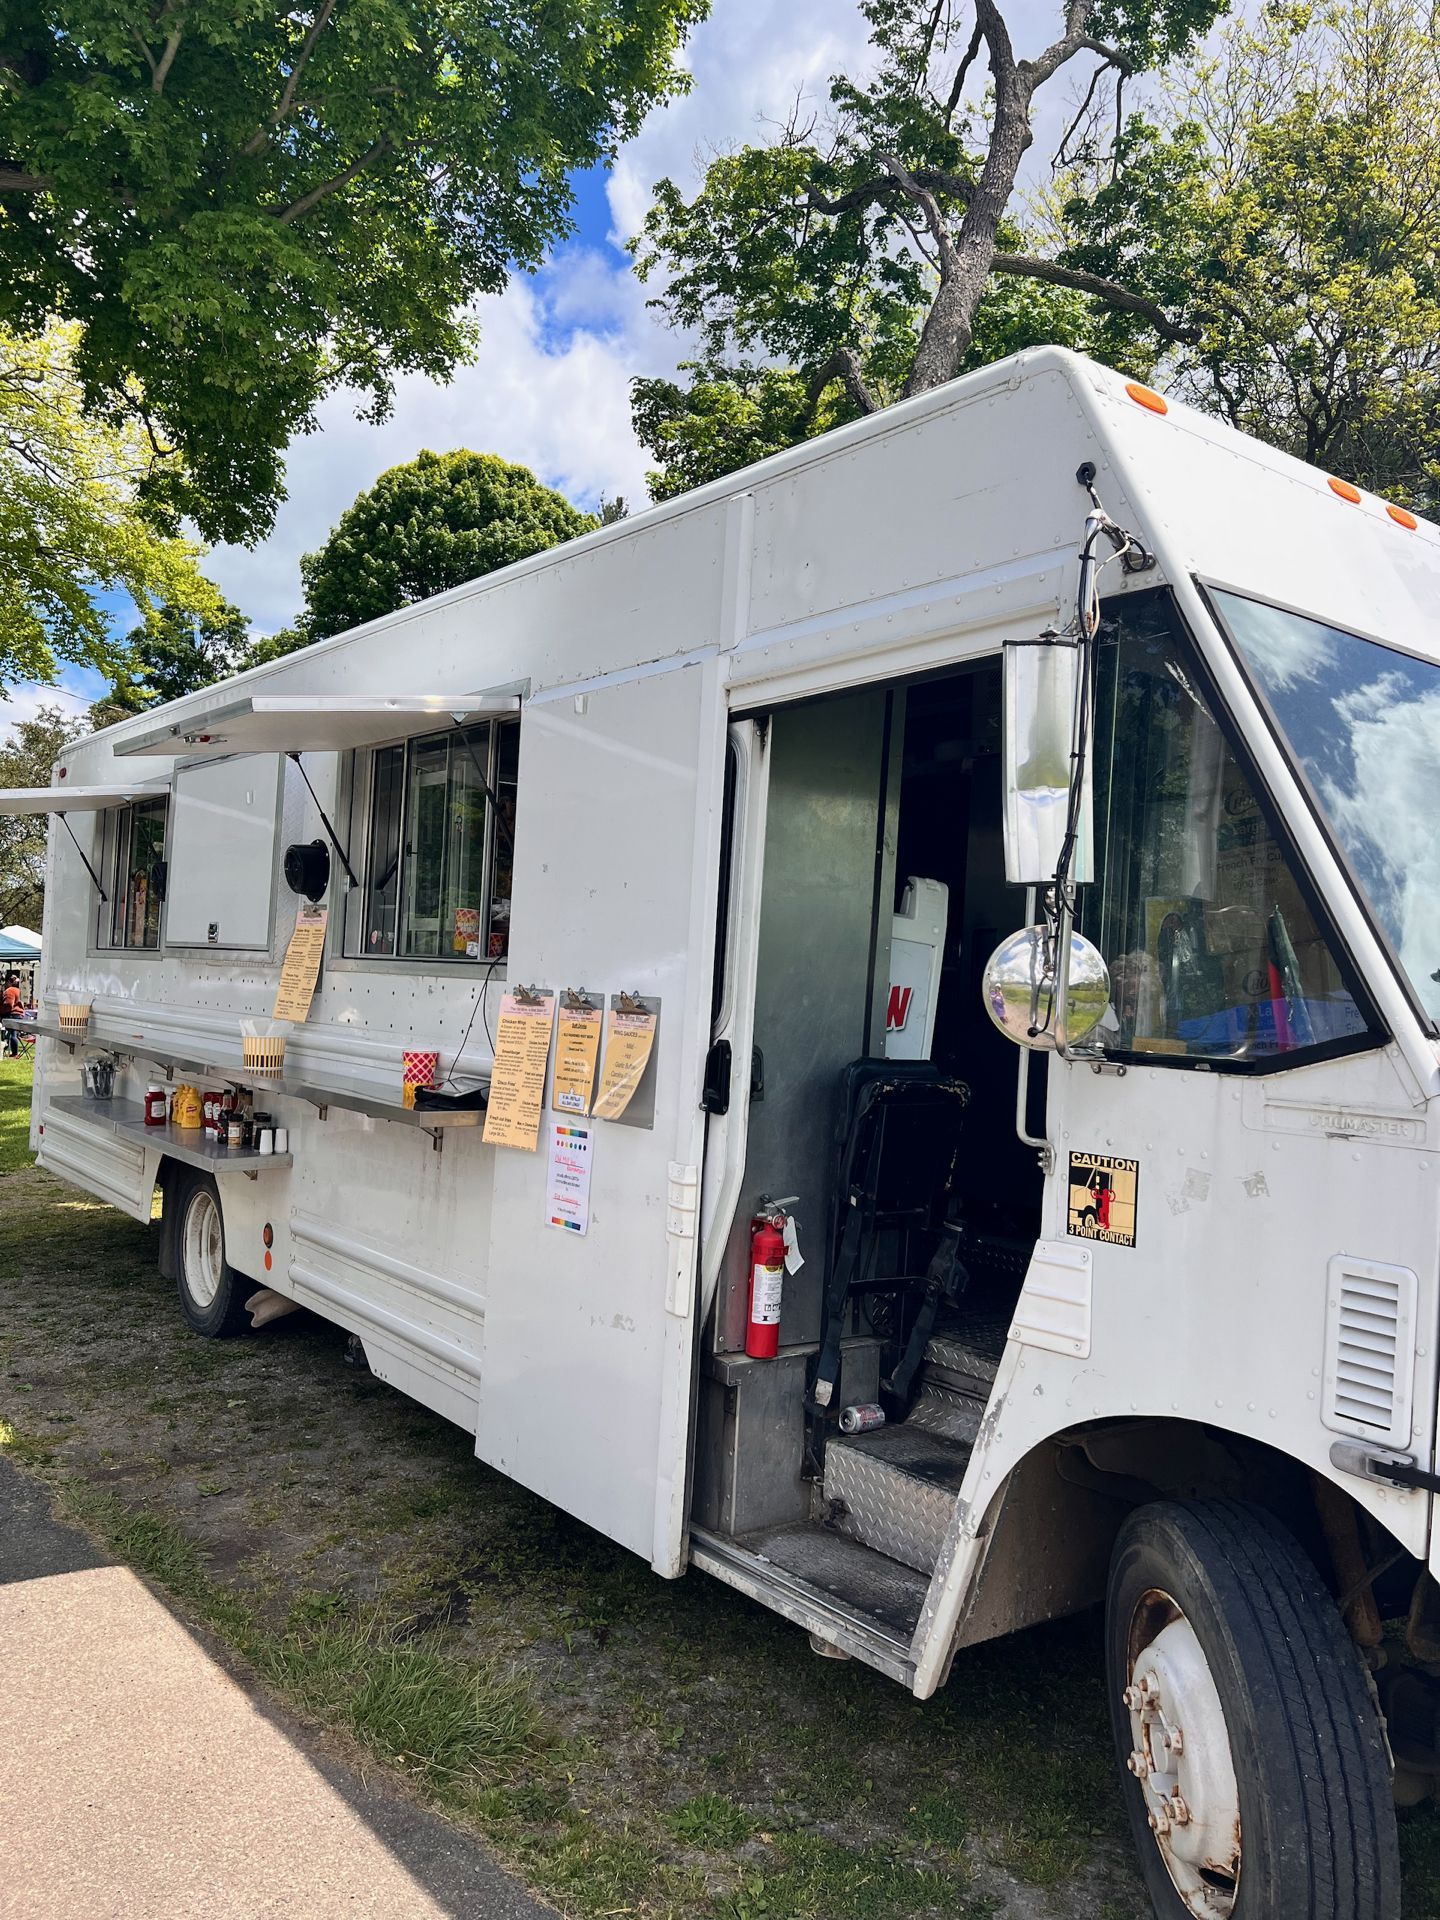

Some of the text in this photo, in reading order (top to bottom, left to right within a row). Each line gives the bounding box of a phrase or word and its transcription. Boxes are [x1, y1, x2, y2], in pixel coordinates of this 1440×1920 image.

[1217, 858, 1248, 872] French
[1309, 1114, 1408, 1137] UTILIMASTER
[1071, 1152, 1137, 1172] CAUTION
[1069, 1224, 1134, 1246] 3 POINT CONTACT
